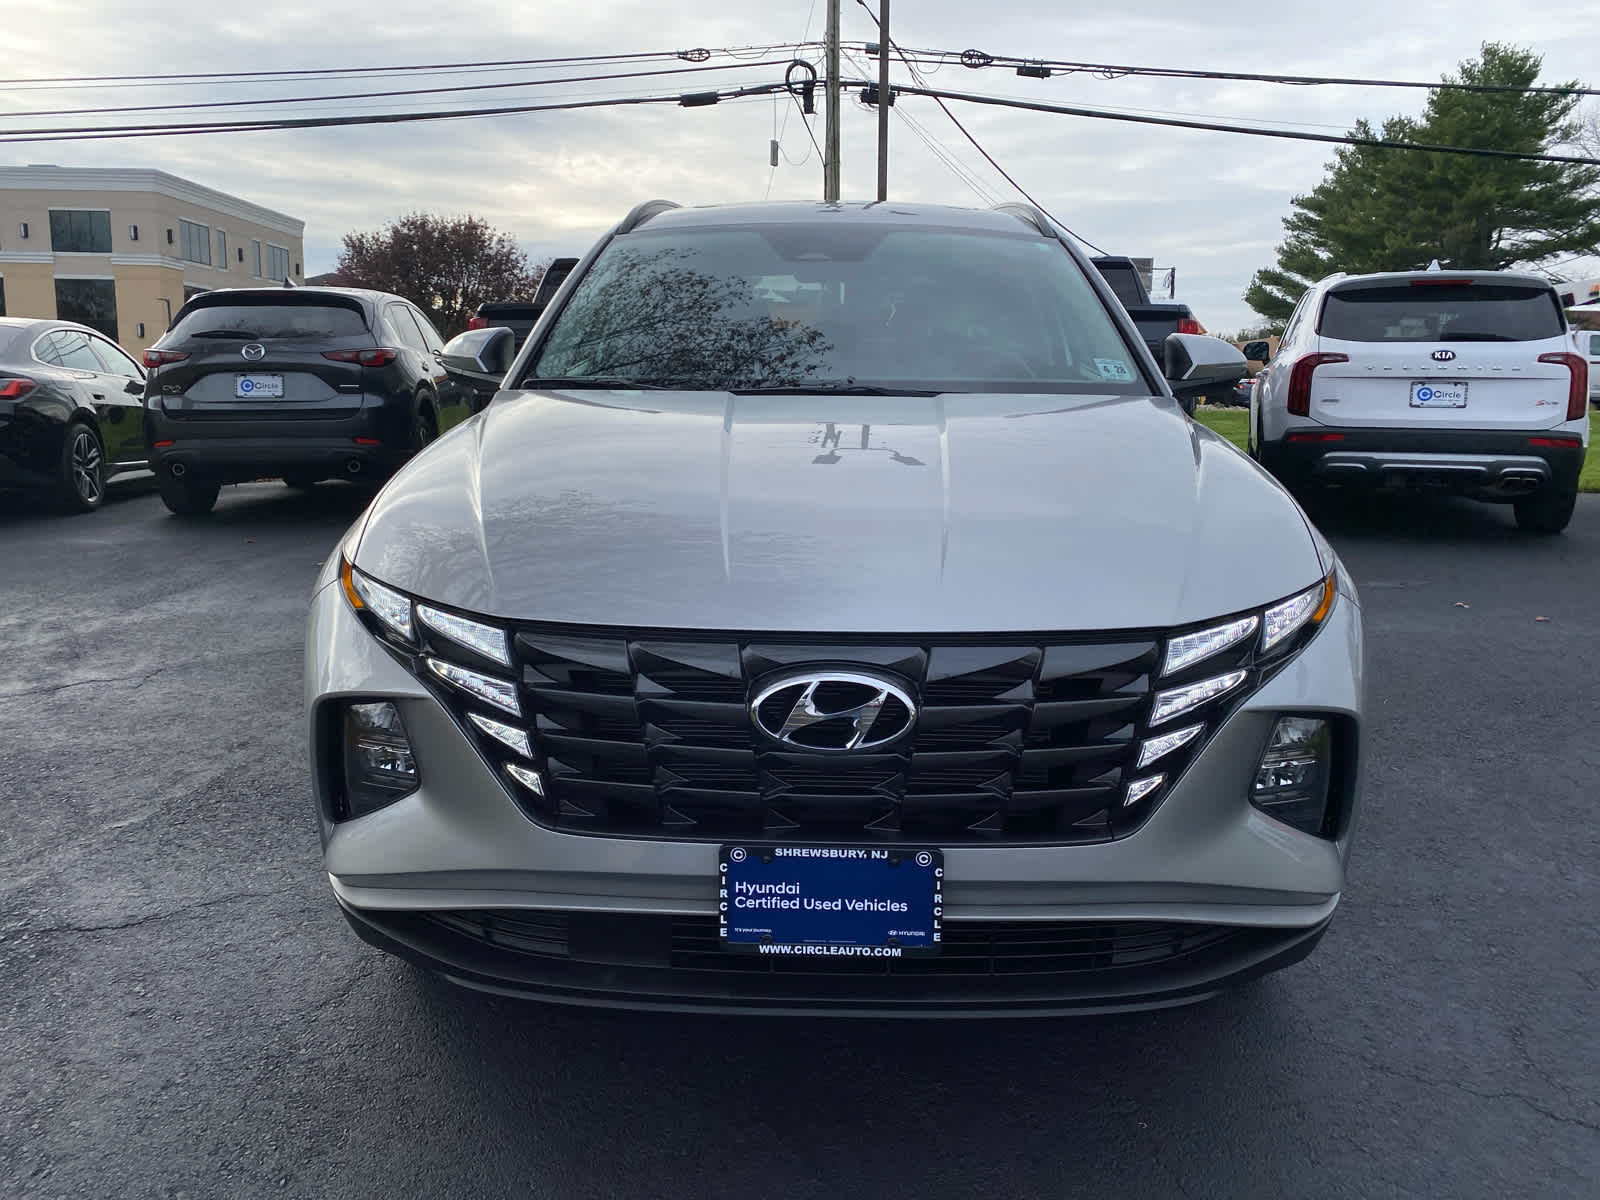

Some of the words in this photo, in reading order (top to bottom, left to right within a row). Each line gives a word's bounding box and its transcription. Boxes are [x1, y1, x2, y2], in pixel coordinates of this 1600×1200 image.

[1434, 351, 1453, 359] KIA
[1433, 390, 1461, 399] Circle
[775, 848, 867, 859] SHREWSBURY,
[871, 850, 888, 859] NJ
[735, 881, 800, 896] Hyundai
[719, 863, 728, 937] CIRCLE
[735, 896, 800, 909] Certified
[803, 898, 842, 910] Used
[845, 898, 908, 912] Vehicles
[933, 868, 943, 942] CIRCLE
[759, 944, 902, 957] WWW.CIRCLEAUTO.COM
